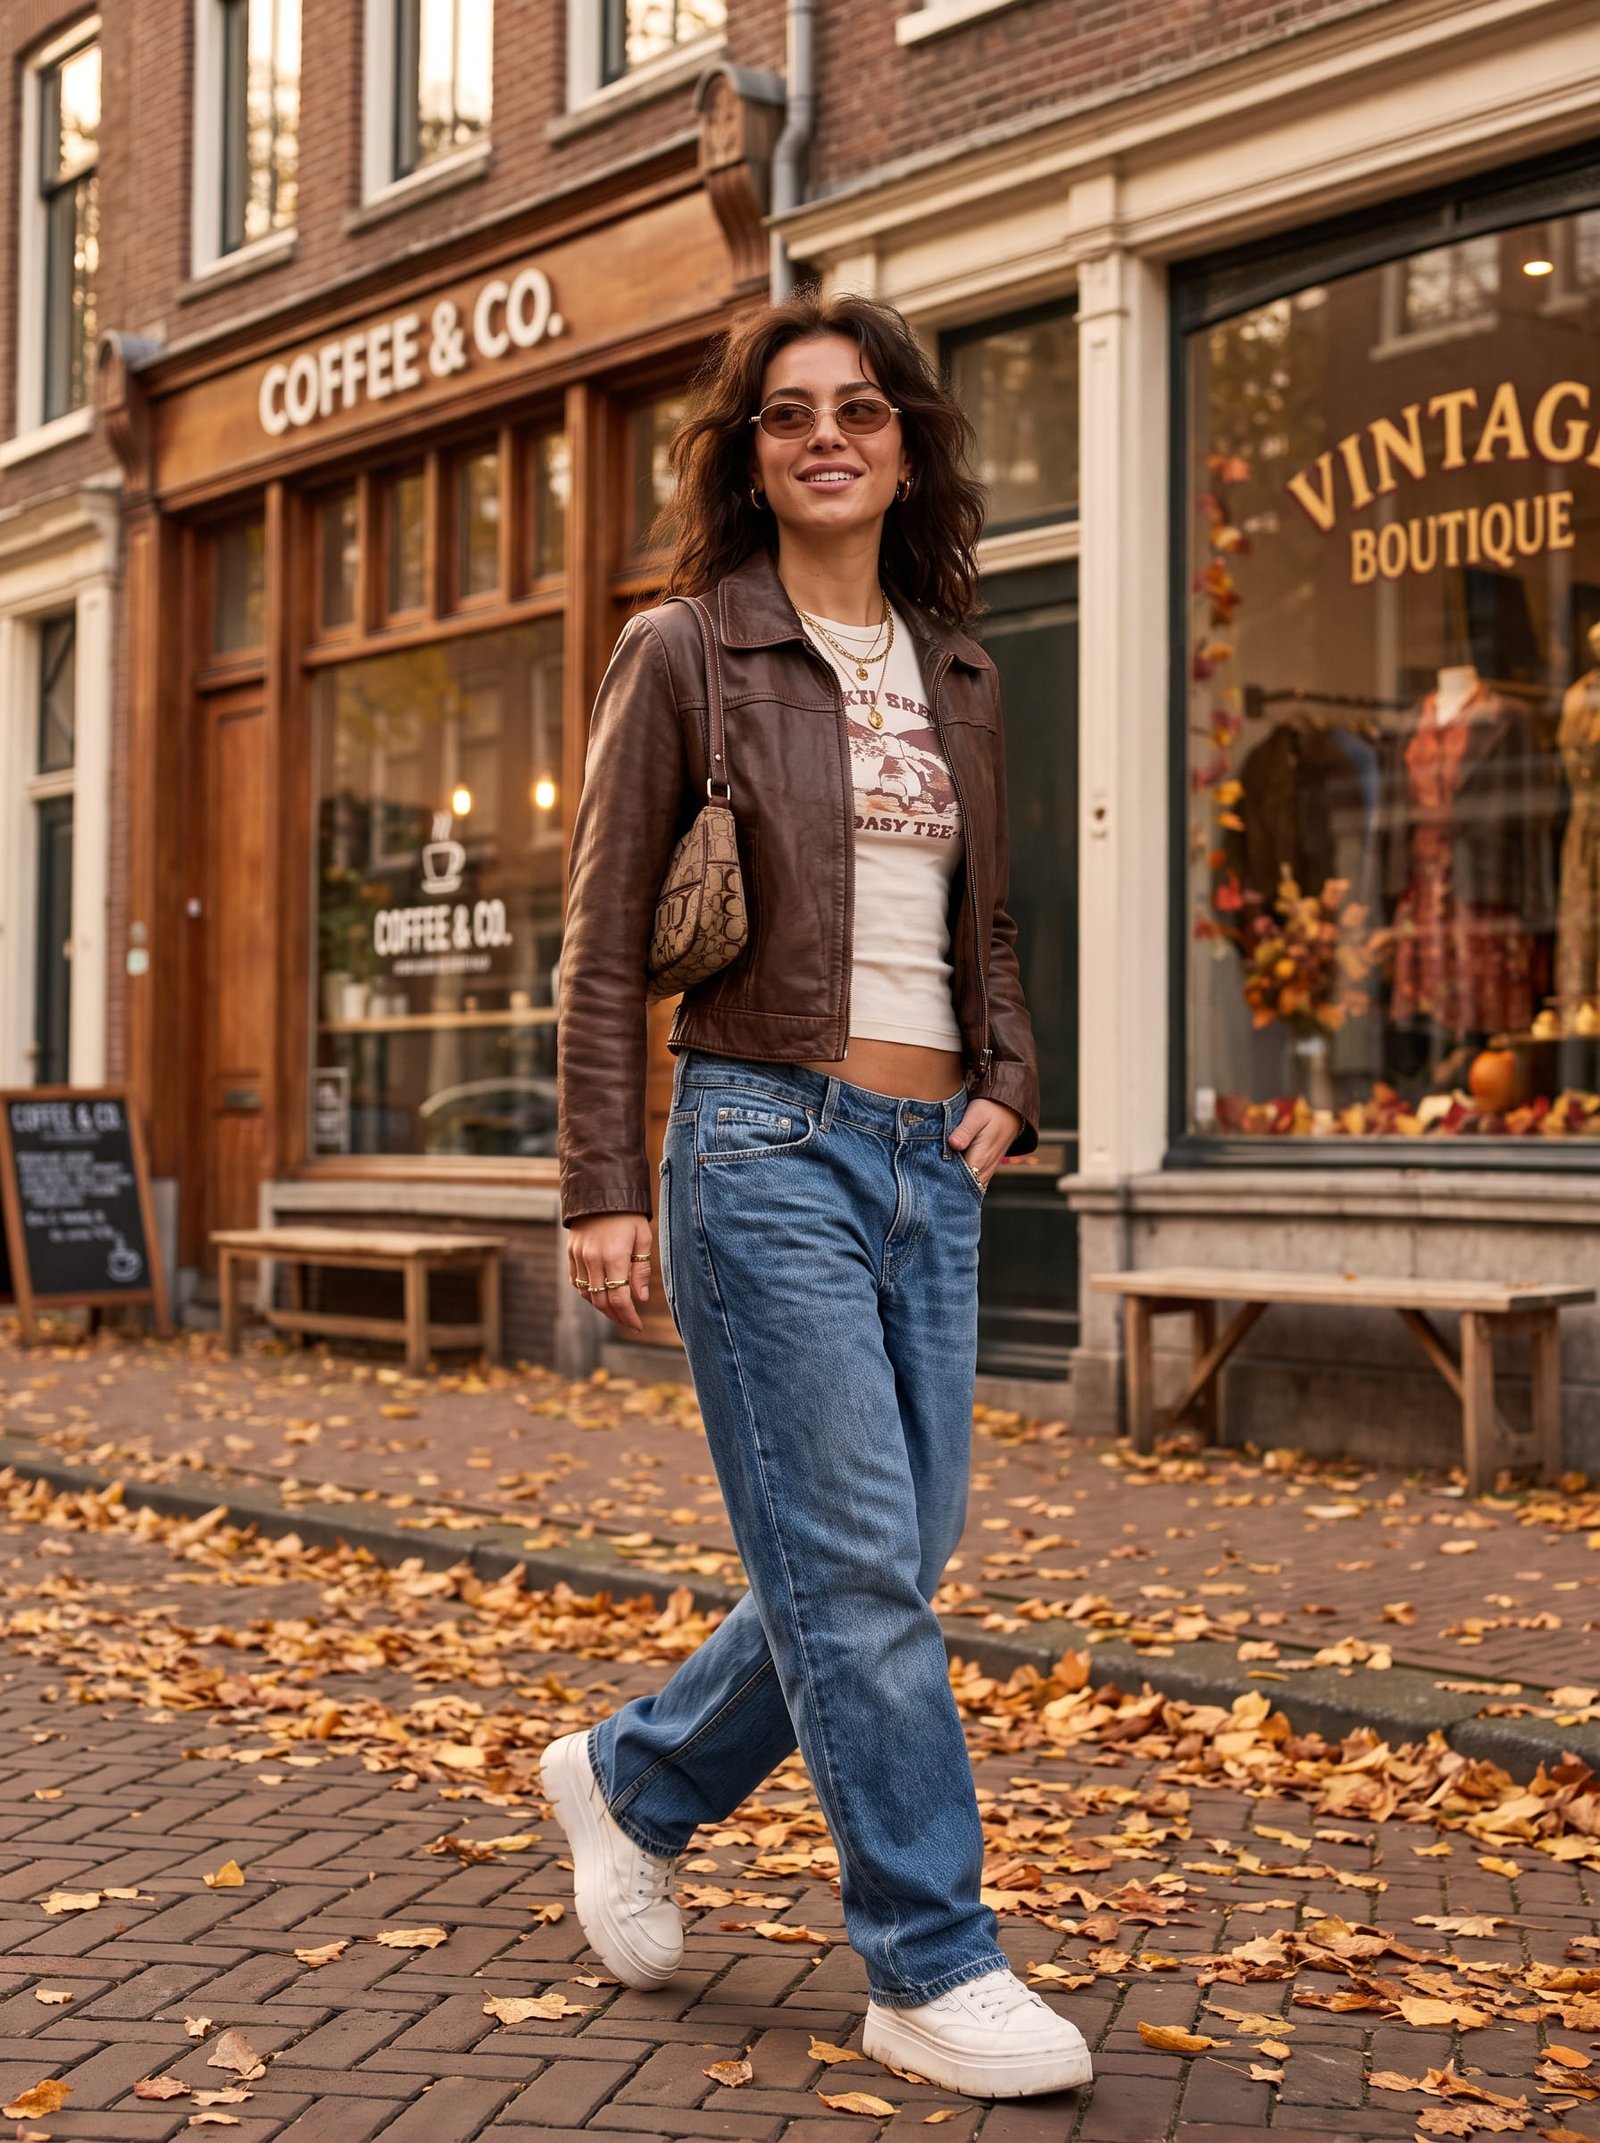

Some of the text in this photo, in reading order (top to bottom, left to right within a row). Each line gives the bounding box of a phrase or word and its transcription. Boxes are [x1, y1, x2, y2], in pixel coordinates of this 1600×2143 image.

[259, 267, 564, 436] COFFEE & CO.
[1351, 490, 1576, 585] BOUTIQUE
[374, 899, 513, 955] COFFEE & CO.
[11, 1102, 74, 1132] COFFEE
